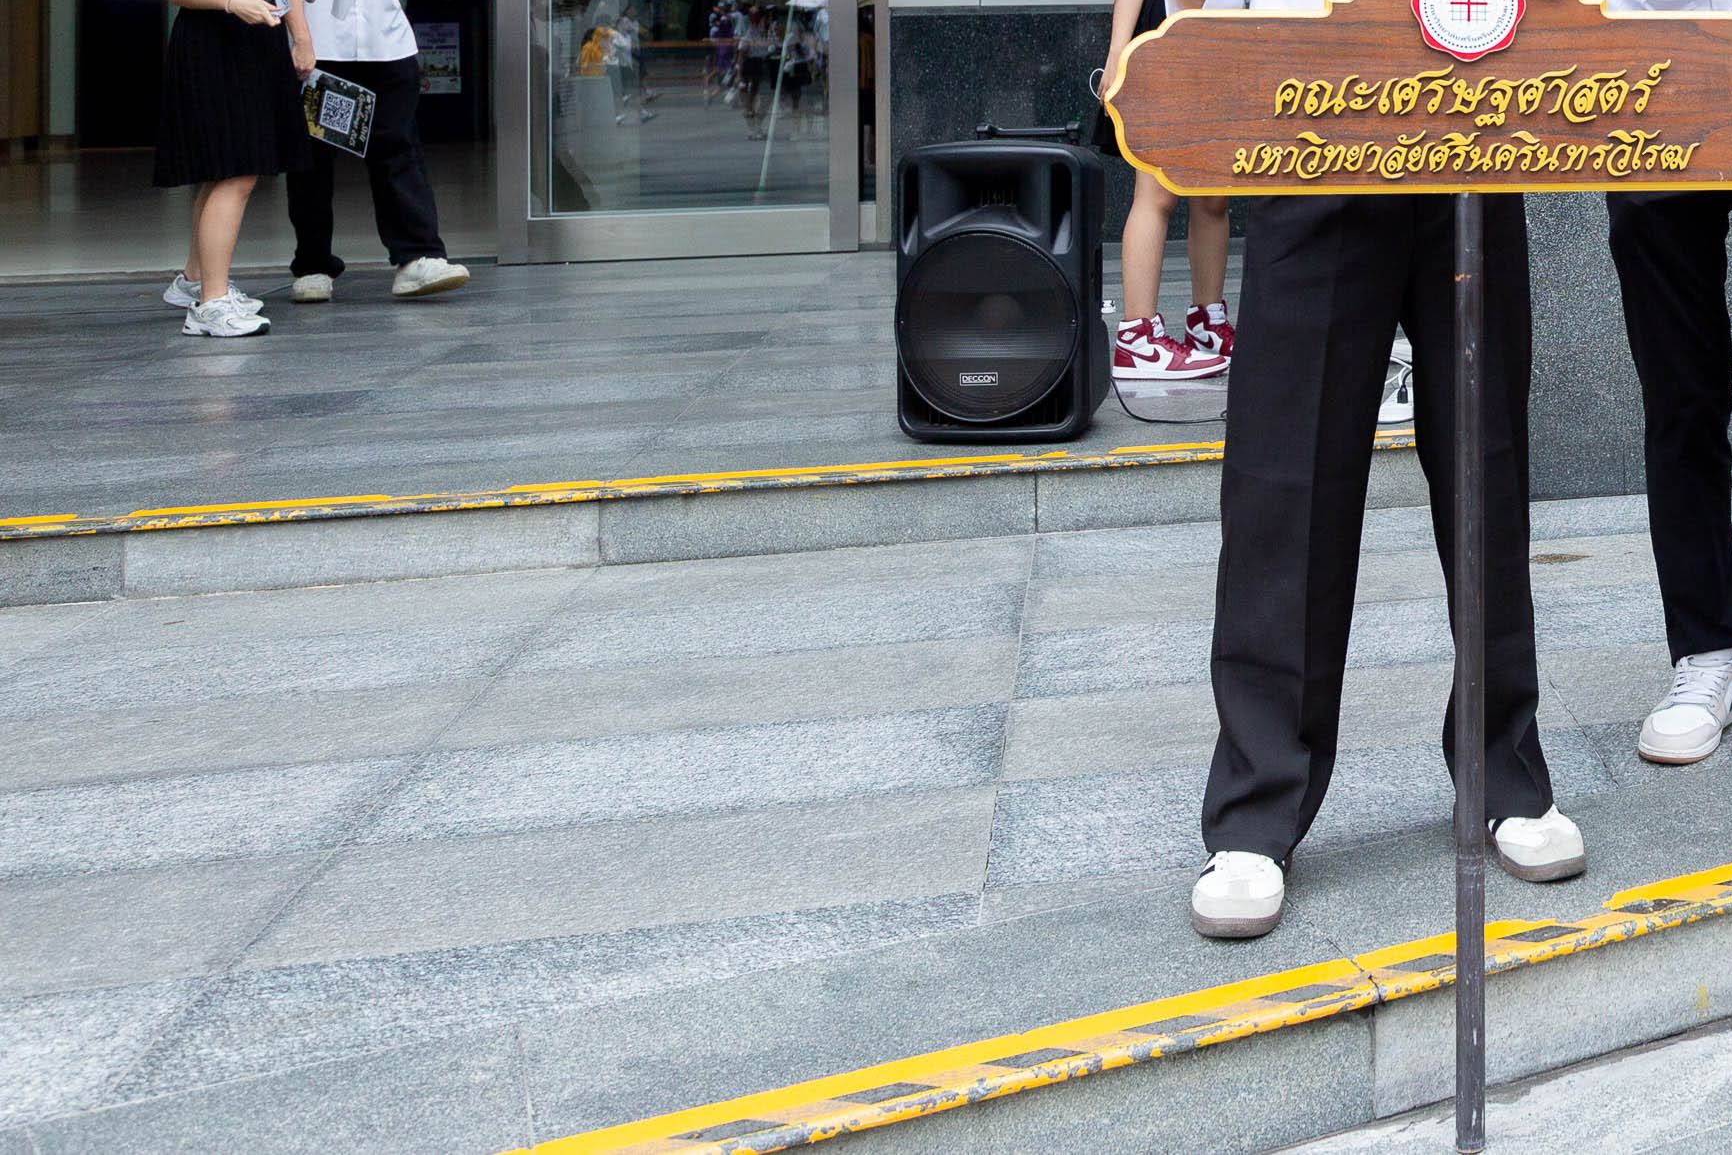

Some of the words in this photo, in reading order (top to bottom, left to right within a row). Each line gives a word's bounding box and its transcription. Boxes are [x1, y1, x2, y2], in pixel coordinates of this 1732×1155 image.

[1274, 59, 1672, 128] คณะเศรษฐศาสตร์
[1232, 129, 1700, 180] มหาวิทยาลัยศรีนครินทรวิโรฒ
[962, 375, 996, 383] DECCON
